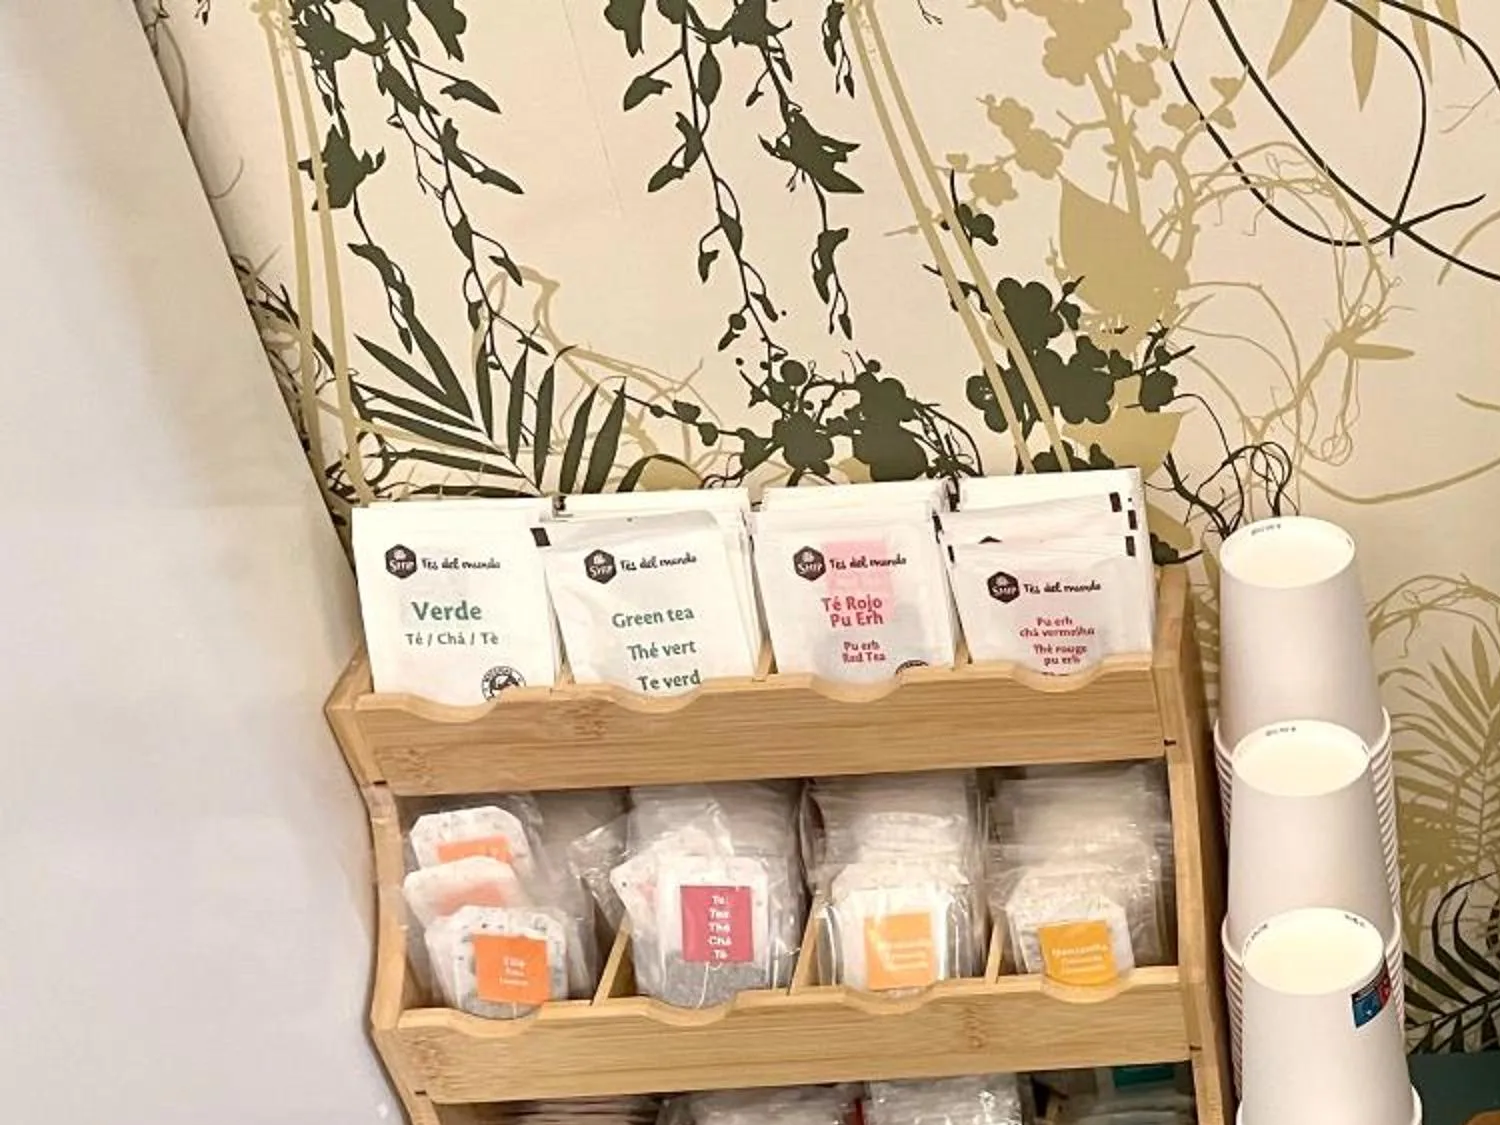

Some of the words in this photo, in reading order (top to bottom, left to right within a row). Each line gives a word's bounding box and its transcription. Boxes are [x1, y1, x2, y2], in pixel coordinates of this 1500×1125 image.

[442, 556, 460, 570] del
[462, 557, 501, 570] mundo
[639, 555, 657, 570] del
[659, 553, 697, 568] mundo
[850, 556, 868, 569] del
[869, 553, 907, 568] mundo
[1043, 580, 1062, 594] del
[1063, 580, 1101, 593] mundo
[411, 601, 482, 621] Verde
[821, 595, 842, 612] Té
[846, 596, 882, 615] Rojo
[612, 611, 664, 629] Green
[667, 607, 695, 622] tea
[830, 613, 852, 628] Pu
[856, 611, 884, 626] Erh
[1037, 616, 1053, 627] Pu
[1054, 616, 1073, 627] erh
[405, 632, 424, 646] Té
[437, 631, 466, 645] Chá
[1041, 624, 1095, 638] vermelho
[627, 642, 658, 662] Thé
[662, 639, 697, 657] vert
[844, 641, 859, 652] Pu
[861, 640, 880, 651] erh
[1056, 644, 1088, 657] rouge
[842, 652, 865, 663] Red
[867, 651, 886, 662] Tea
[1044, 656, 1059, 667] pu
[1061, 653, 1081, 665] erh
[636, 674, 660, 691] Te
[663, 670, 700, 689] verd
